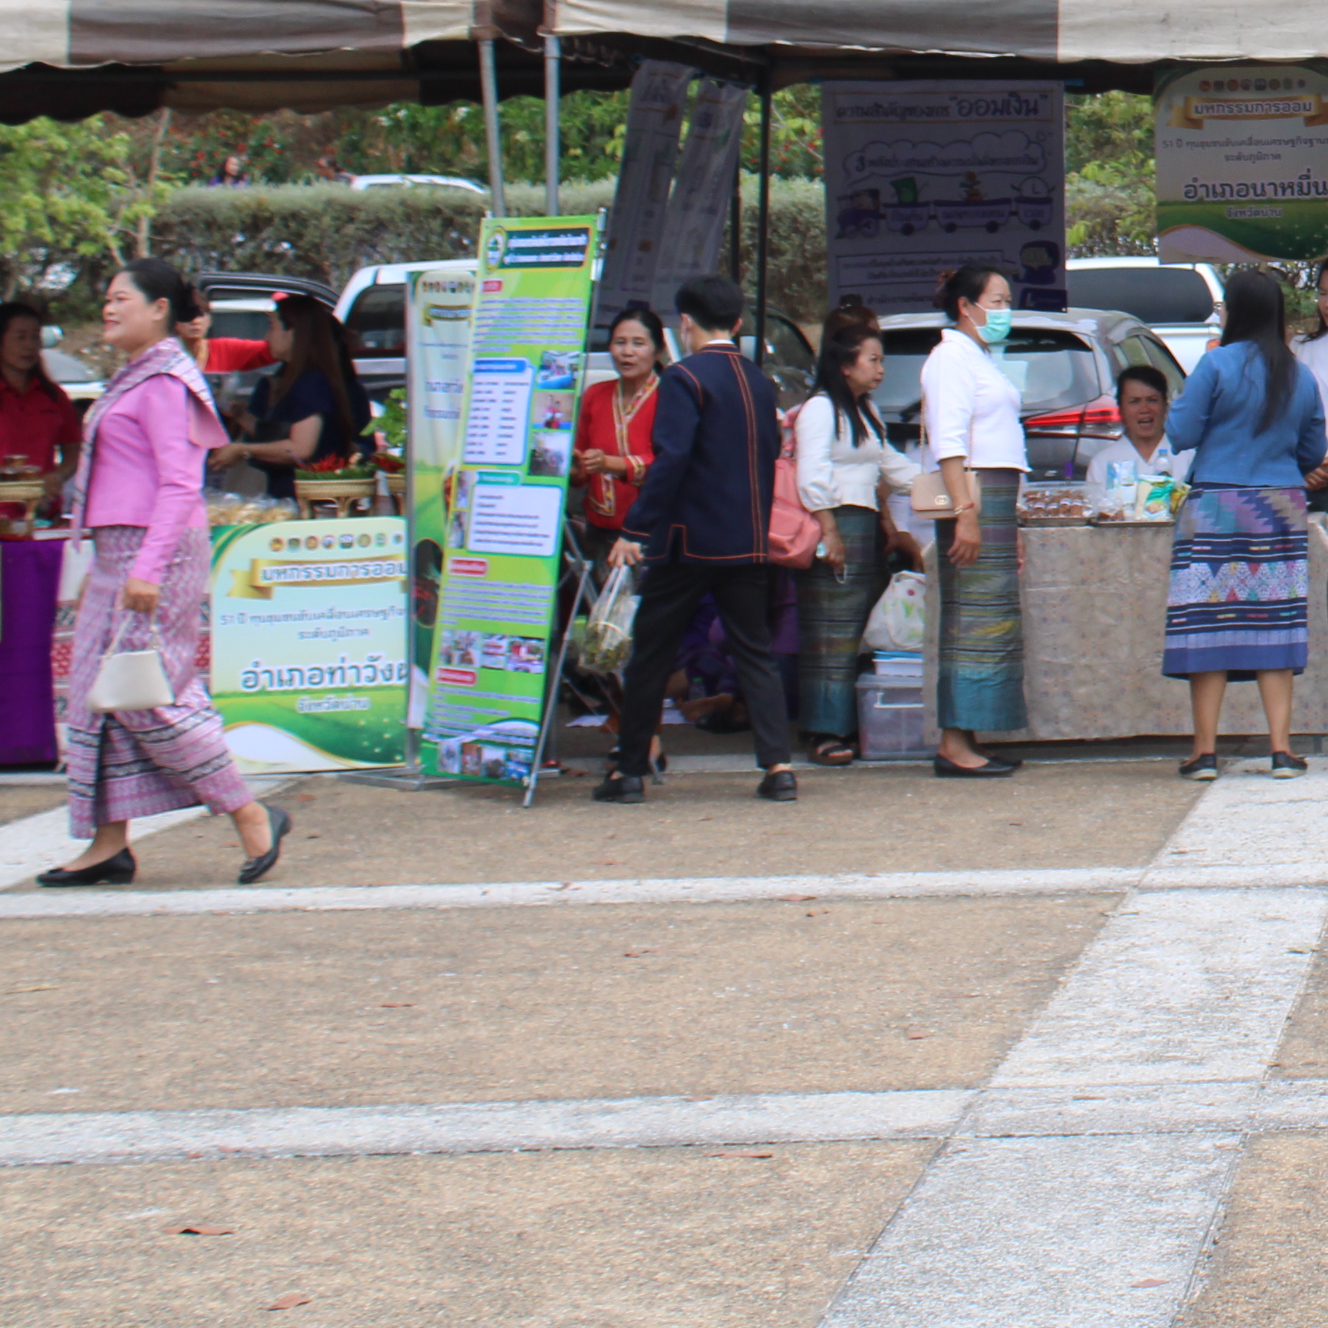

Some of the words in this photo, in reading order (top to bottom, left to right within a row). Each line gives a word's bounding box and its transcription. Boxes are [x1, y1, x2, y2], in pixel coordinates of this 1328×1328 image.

[1193, 100, 1313, 115] มหกรรมการออม
[1183, 168, 1328, 200] อำเภอนาหมื่น
